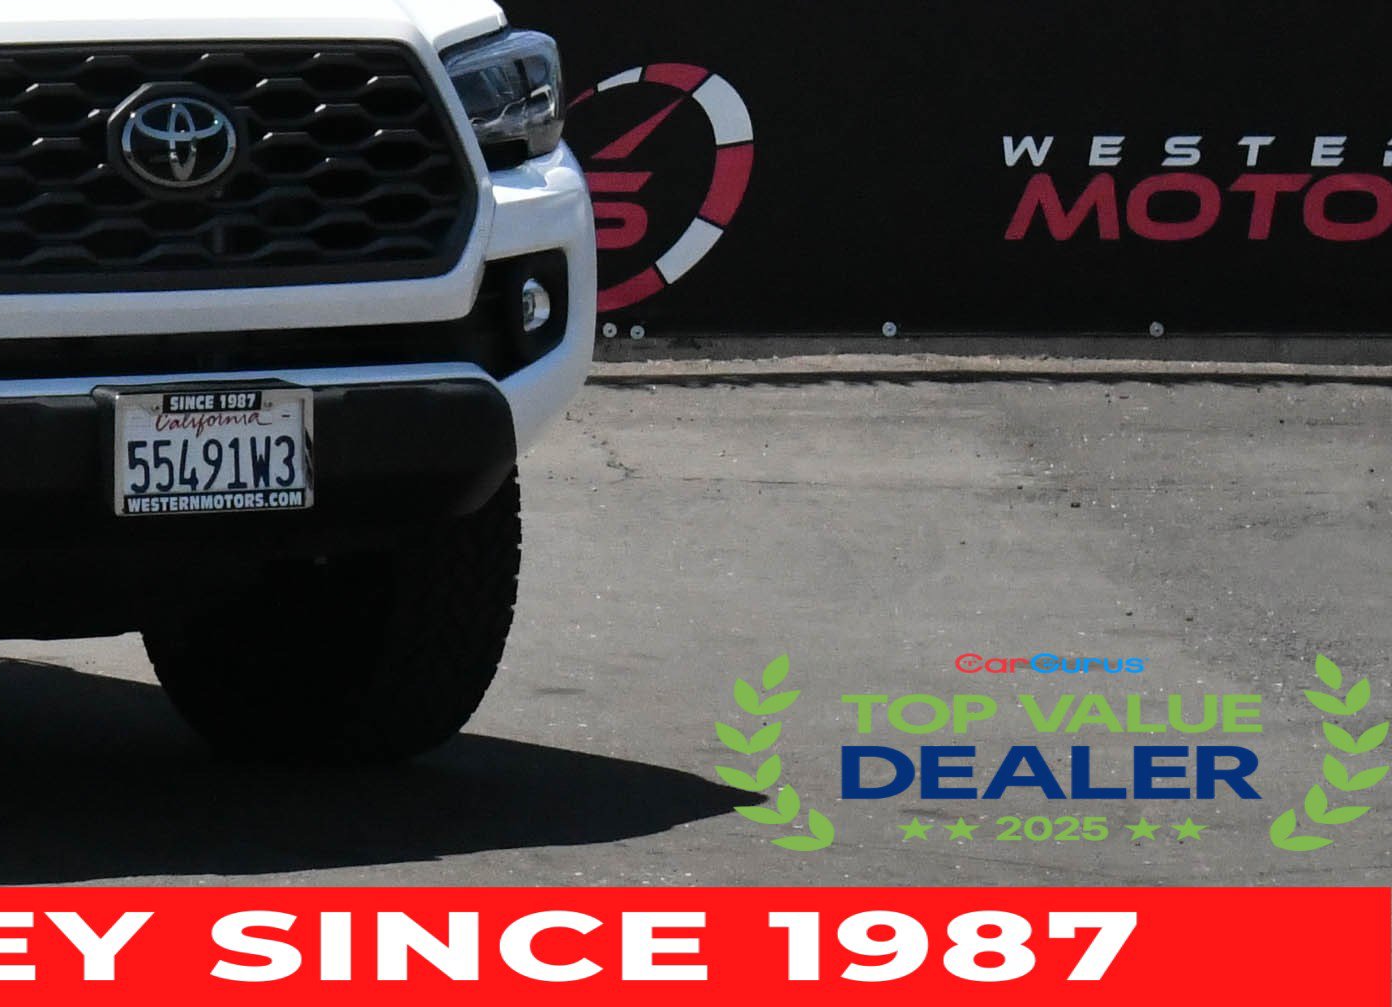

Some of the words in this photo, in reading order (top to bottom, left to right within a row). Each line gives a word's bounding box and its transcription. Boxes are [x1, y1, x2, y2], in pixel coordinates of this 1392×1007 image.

[1002, 135, 1392, 167] WESTE
[170, 395, 215, 411] SINCE
[220, 393, 257, 408] 1987
[155, 412, 272, 438] California
[128, 436, 295, 492] 55491W3
[127, 492, 302, 513] WESTERNMOTORS.COM
